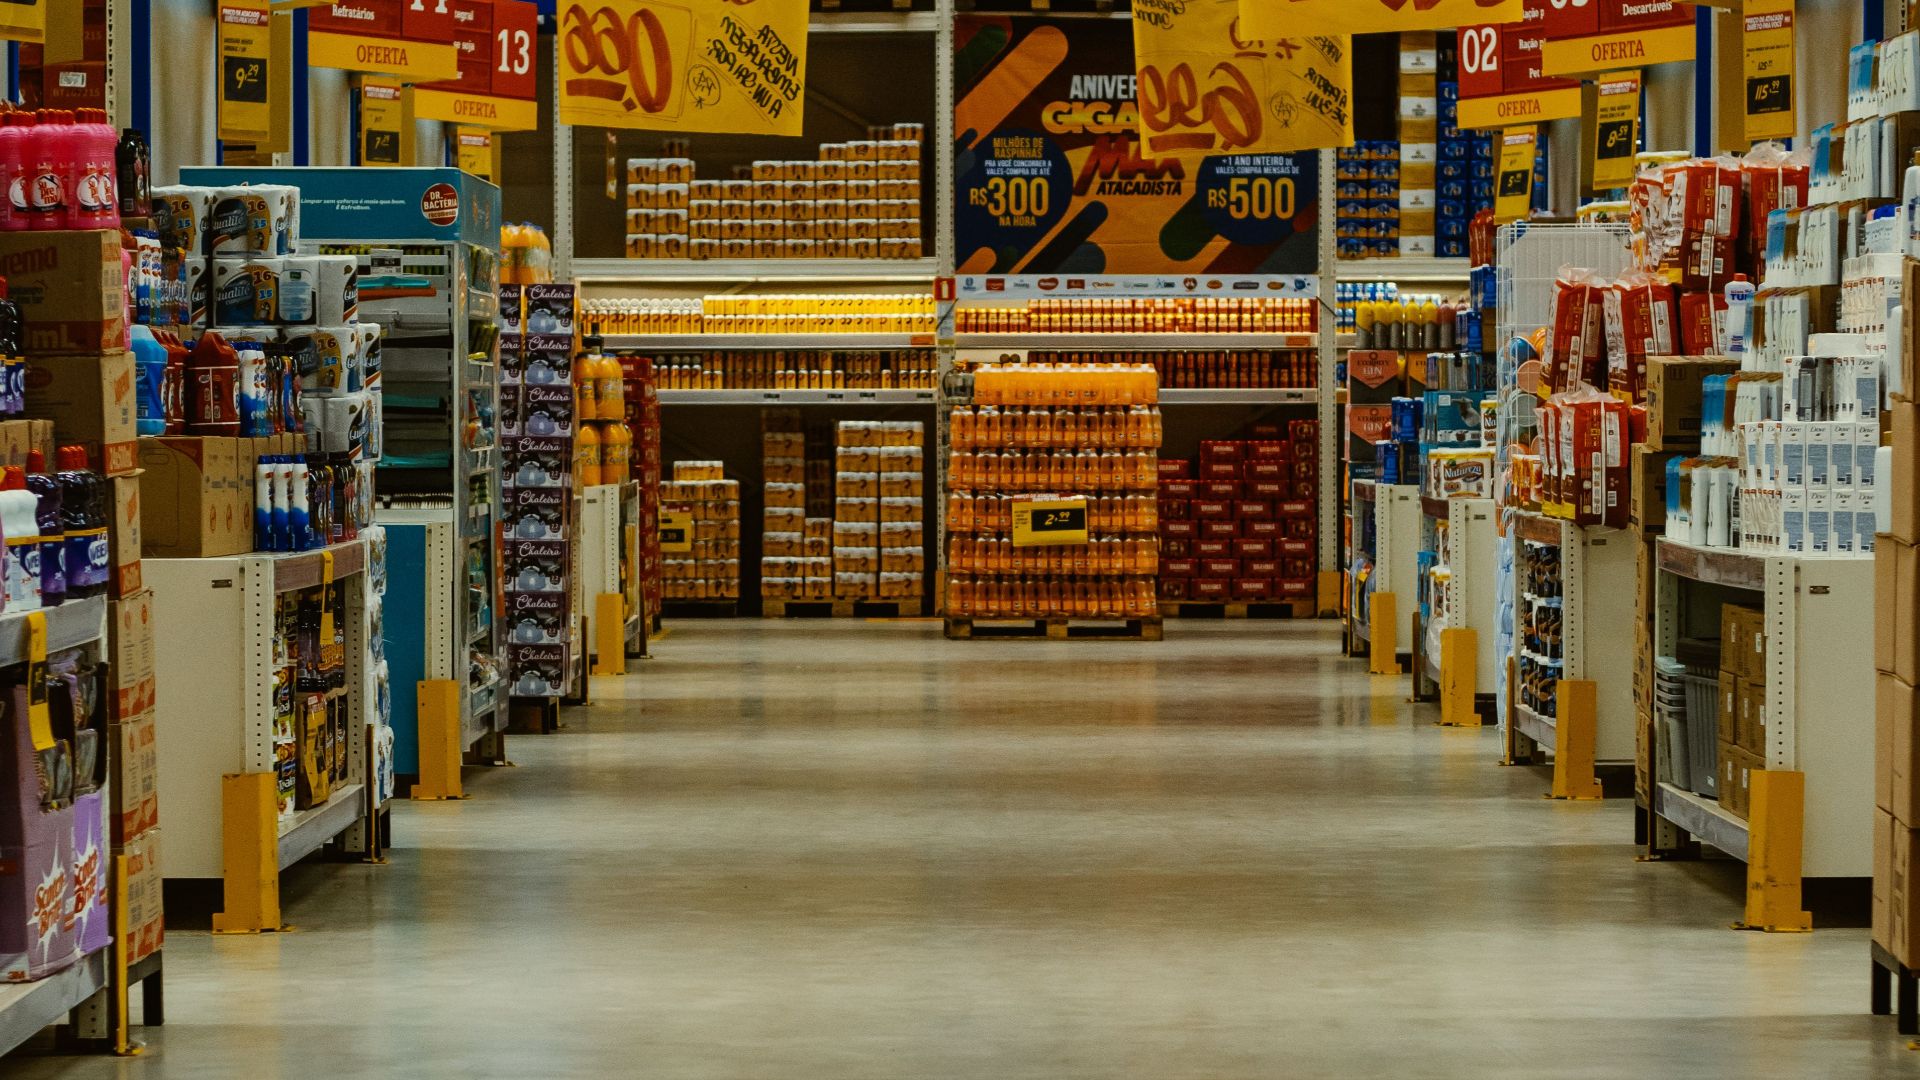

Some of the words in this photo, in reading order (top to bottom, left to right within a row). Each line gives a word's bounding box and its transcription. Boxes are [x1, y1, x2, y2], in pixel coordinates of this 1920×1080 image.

[332, 4, 375, 21] Refratários
[1522, 8, 1539, 20] ação
[497, 29, 530, 75] 13
[1462, 26, 1498, 74] 02
[1518, 38, 1538, 51] Ração
[1591, 39, 1646, 62] OFERTA
[356, 45, 409, 66] OFERTA
[236, 64, 259, 89] 9,29
[1529, 68, 1541, 79] Pet
[1755, 80, 1780, 101] 115,99
[453, 99, 497, 119] OFERTA
[1497, 99, 1542, 118] OFERTA
[992, 136, 1031, 148] MILHÕES
[1032, 137, 1044, 148] DE
[994, 148, 1043, 159] RASPINHAS
[1234, 156, 1251, 166] ANO
[1252, 156, 1284, 166] INTEIRO
[430, 191, 443, 200] DR.
[1096, 180, 1182, 196] ATACADISTA
[171, 200, 190, 215] 16
[247, 200, 266, 214] 16
[424, 197, 458, 210] BACTÉRIA
[999, 216, 1011, 227] NA
[1012, 216, 1036, 227] HORA
[253, 271, 272, 285] 16
[258, 289, 273, 299] 15
[530, 285, 572, 300] Chaleira
[1731, 293, 1747, 301] TU
[528, 336, 570, 351] Chaleira
[529, 387, 571, 402] Chaleira
[518, 437, 561, 453] Chaleira
[1445, 465, 1482, 479] Natureza
[518, 490, 561, 505] Chaleira
[1044, 511, 1071, 526] 2,99
[518, 542, 561, 557] Chaleira
[515, 594, 558, 609] Chaleira
[519, 647, 561, 661] Chaleira
